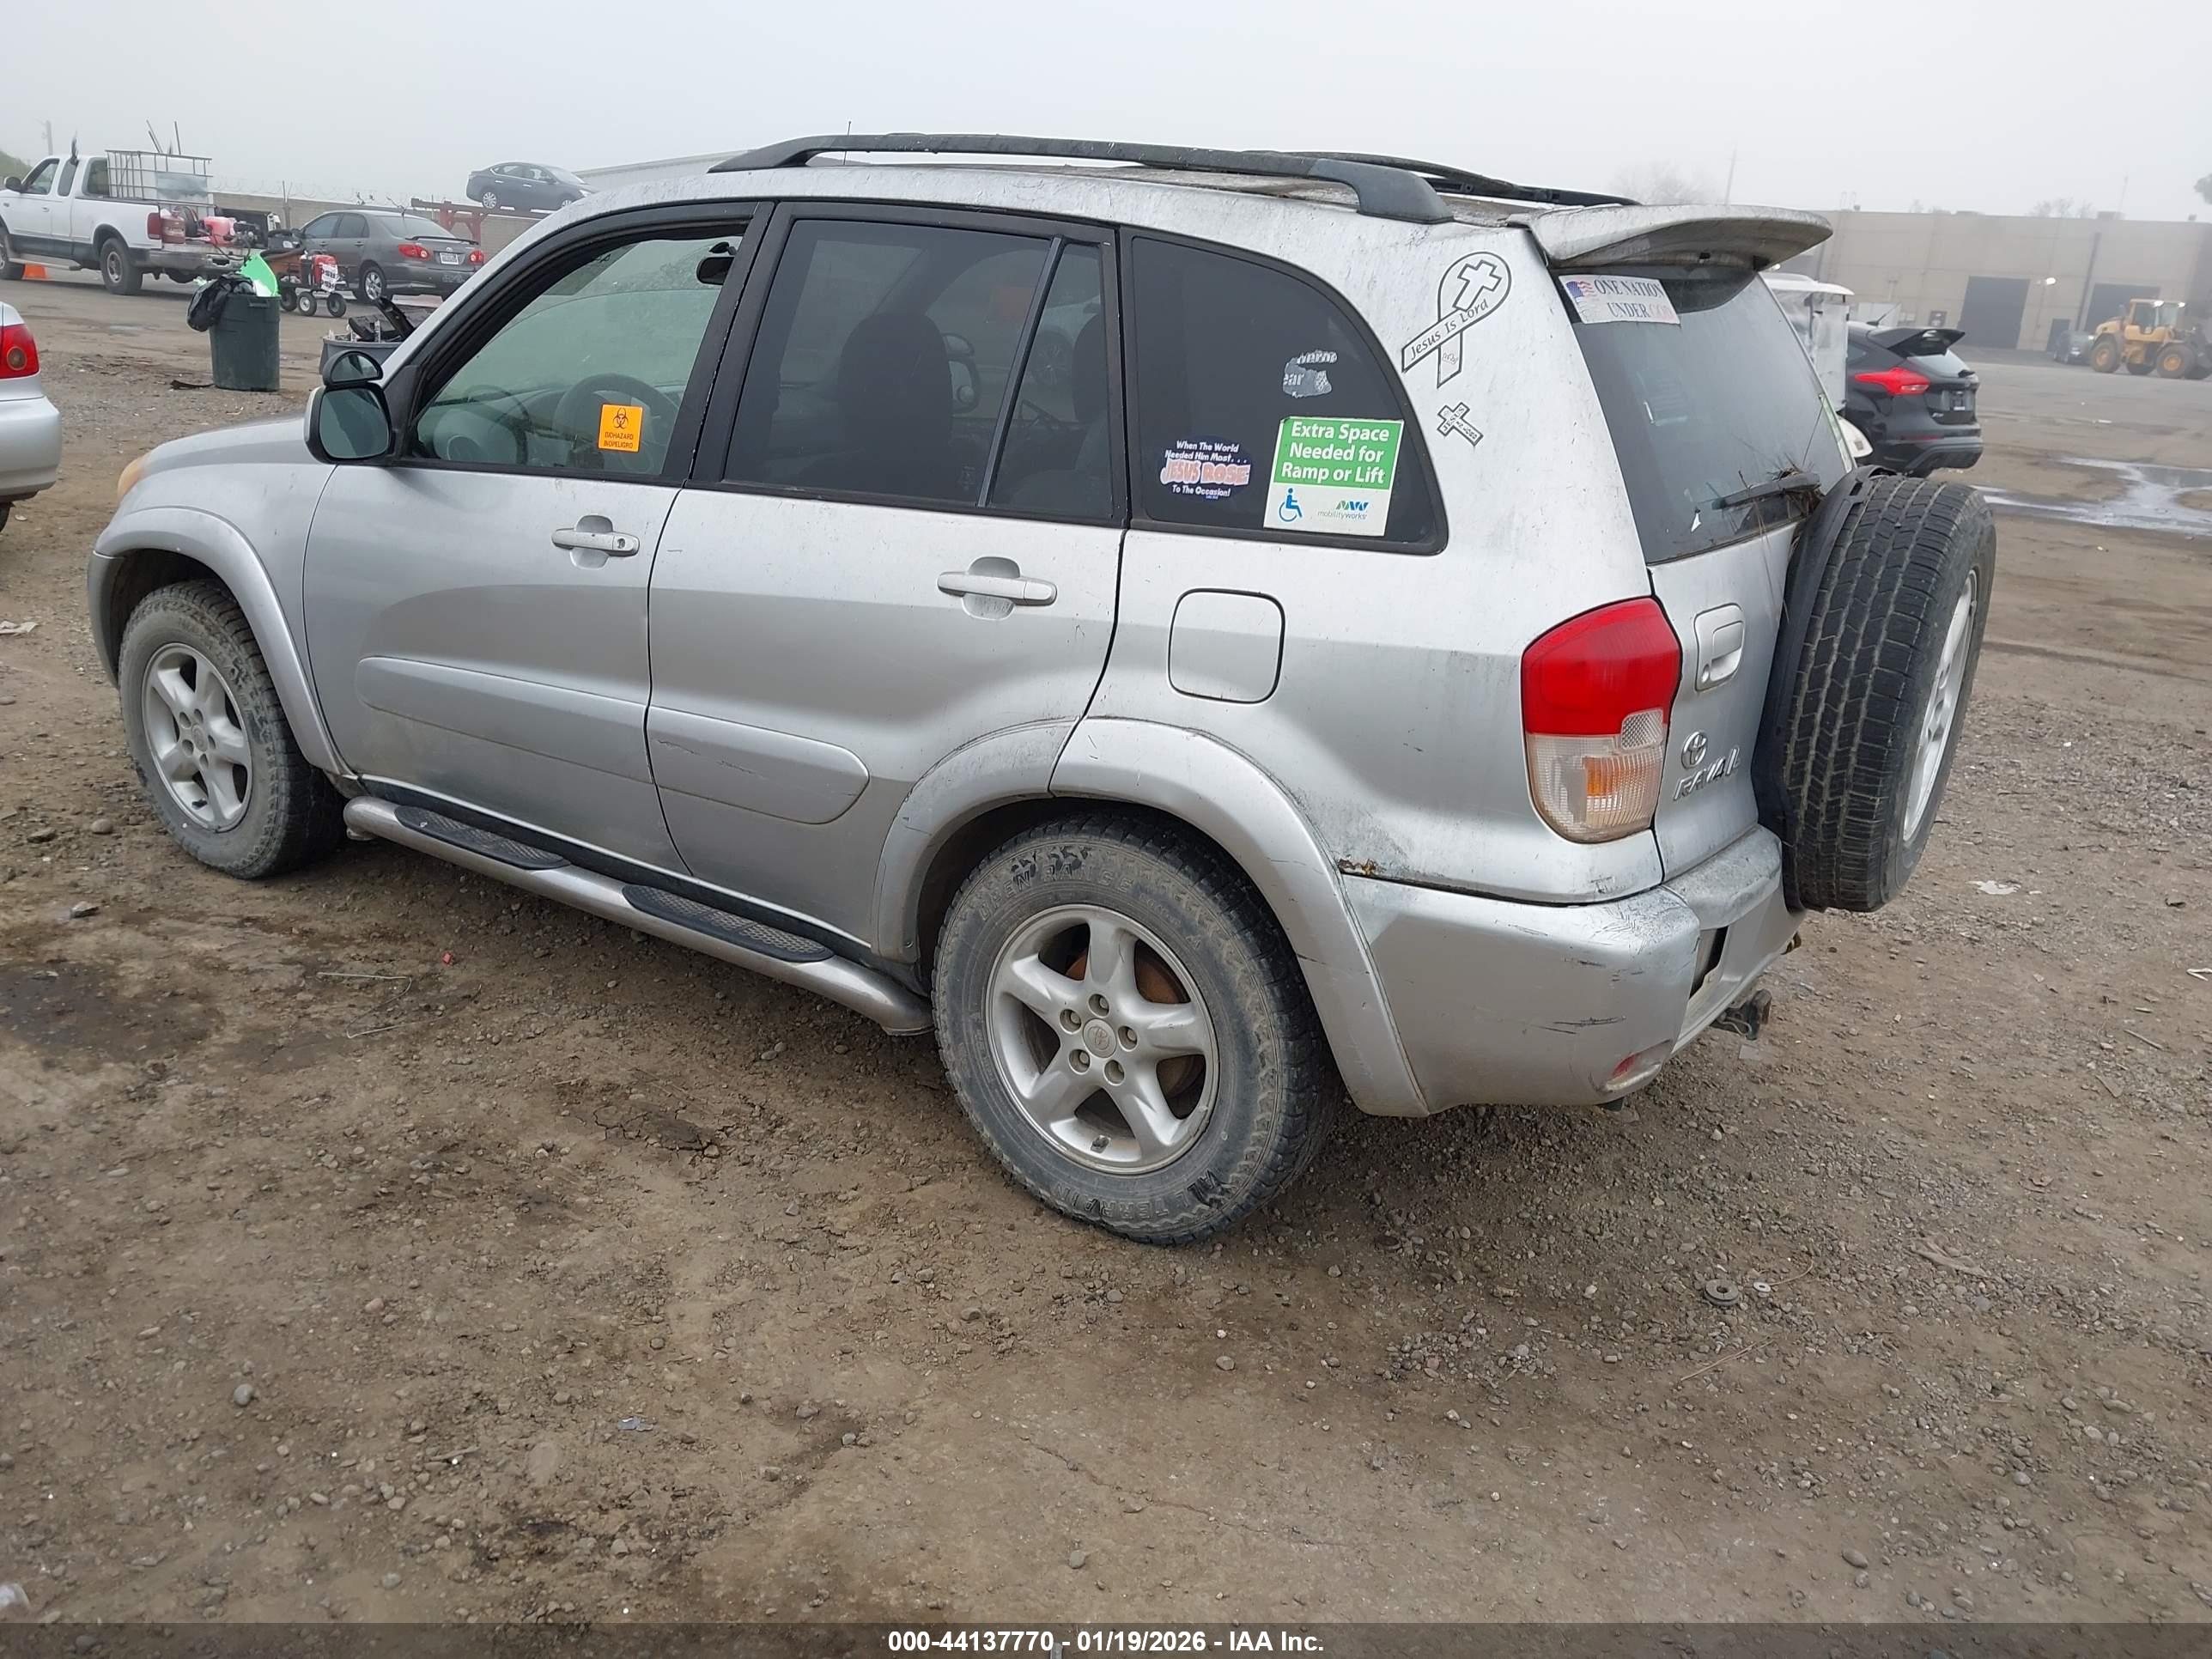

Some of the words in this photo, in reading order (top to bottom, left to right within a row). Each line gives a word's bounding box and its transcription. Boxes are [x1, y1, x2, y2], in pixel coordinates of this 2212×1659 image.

[1594, 279, 1621, 295] ONE
[1620, 281, 1665, 297] NATION
[1607, 302, 1650, 318] UNDER
[1410, 331, 1442, 361] Jesus
[1444, 319, 1457, 334] Is
[1459, 298, 1489, 323] Lord
[1441, 406, 1465, 432] JESUS
[605, 432, 634, 441] BIOHAZARD
[1291, 421, 1334, 439] Extra
[1338, 424, 1390, 444] Space
[604, 441, 633, 449] BIOPELIGRO
[1176, 440, 1198, 450] When
[1199, 441, 1213, 451] The
[1214, 443, 1240, 453] World
[1289, 443, 1357, 461] Needed
[1358, 445, 1384, 464] for
[1164, 450, 1194, 459] Needed
[1194, 452, 1210, 461] Him
[1159, 459, 1201, 485] JESUS
[1200, 462, 1251, 487] ROSE
[1282, 462, 1330, 483] Ramp
[1332, 468, 1352, 482] or
[1354, 466, 1387, 484] Lift
[1172, 484, 1181, 494] To
[1182, 485, 1194, 495] The
[1195, 486, 1231, 497] Occasion!
[1317, 509, 1369, 521] mobilityworks
